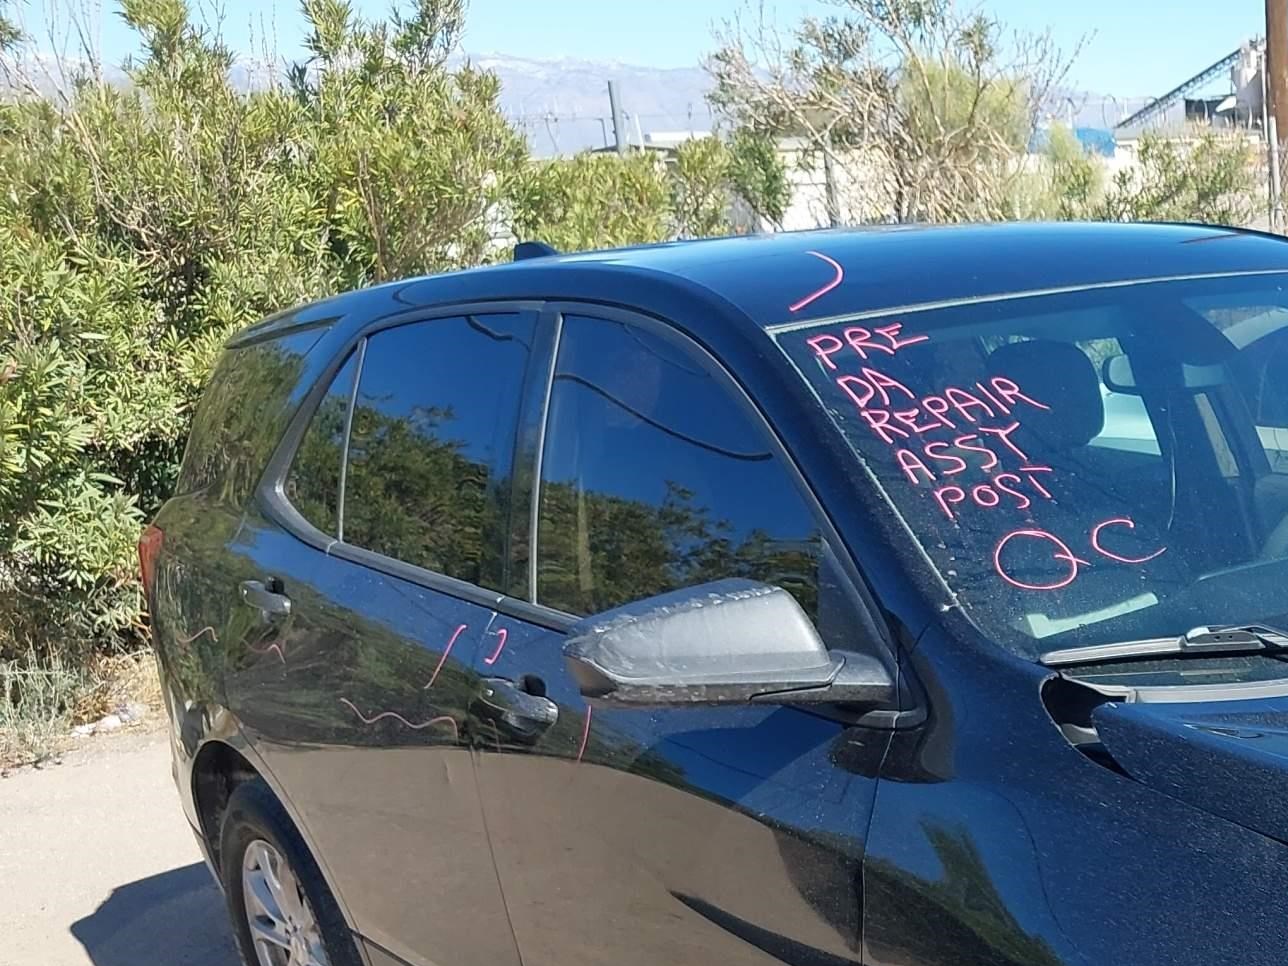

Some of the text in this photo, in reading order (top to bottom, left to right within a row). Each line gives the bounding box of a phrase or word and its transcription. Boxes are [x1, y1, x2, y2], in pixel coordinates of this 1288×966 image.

[807, 323, 929, 370] PRE
[836, 366, 915, 408] DA
[860, 376, 1051, 444] REPAIR
[896, 421, 1029, 485] ASSY
[934, 466, 1053, 519] POST
